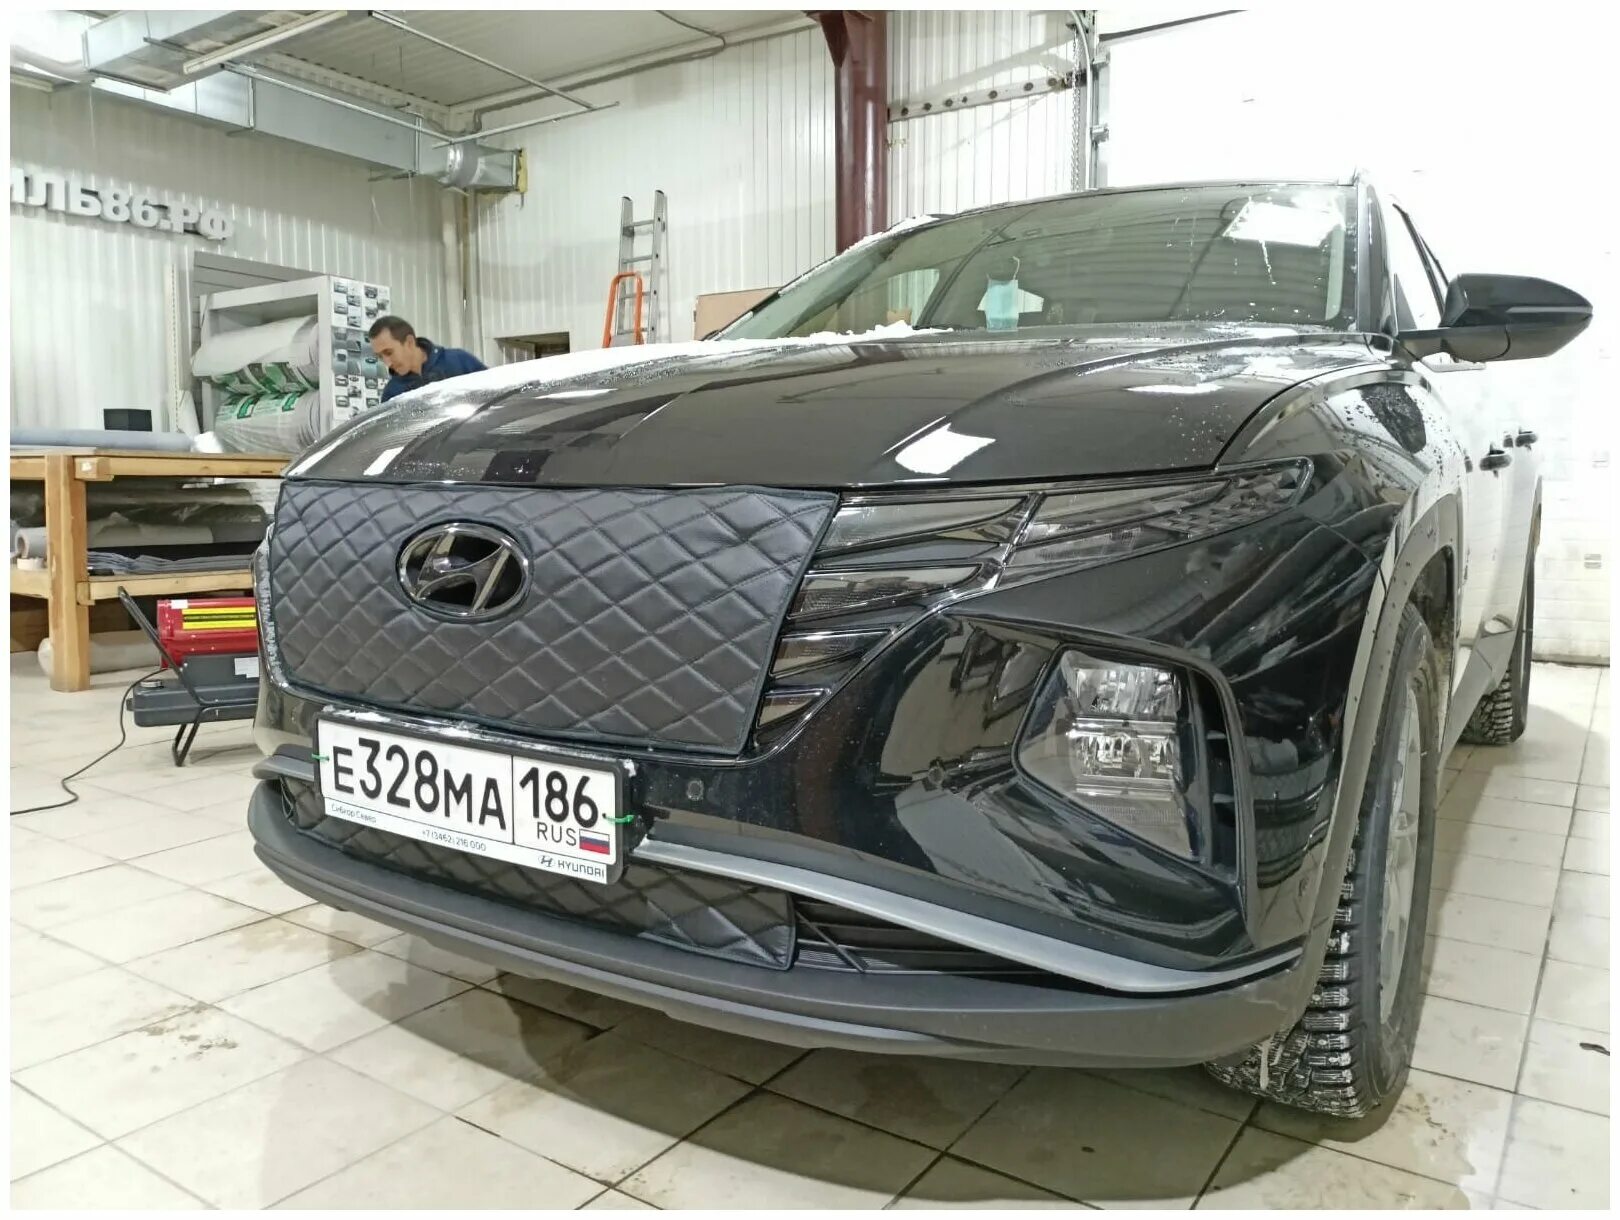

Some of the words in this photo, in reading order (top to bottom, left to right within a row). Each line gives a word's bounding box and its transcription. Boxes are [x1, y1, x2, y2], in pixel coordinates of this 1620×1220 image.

[519, 766, 599, 829] 186
[536, 821, 577, 847] RUS
[557, 860, 605, 878] HYUNDAI
